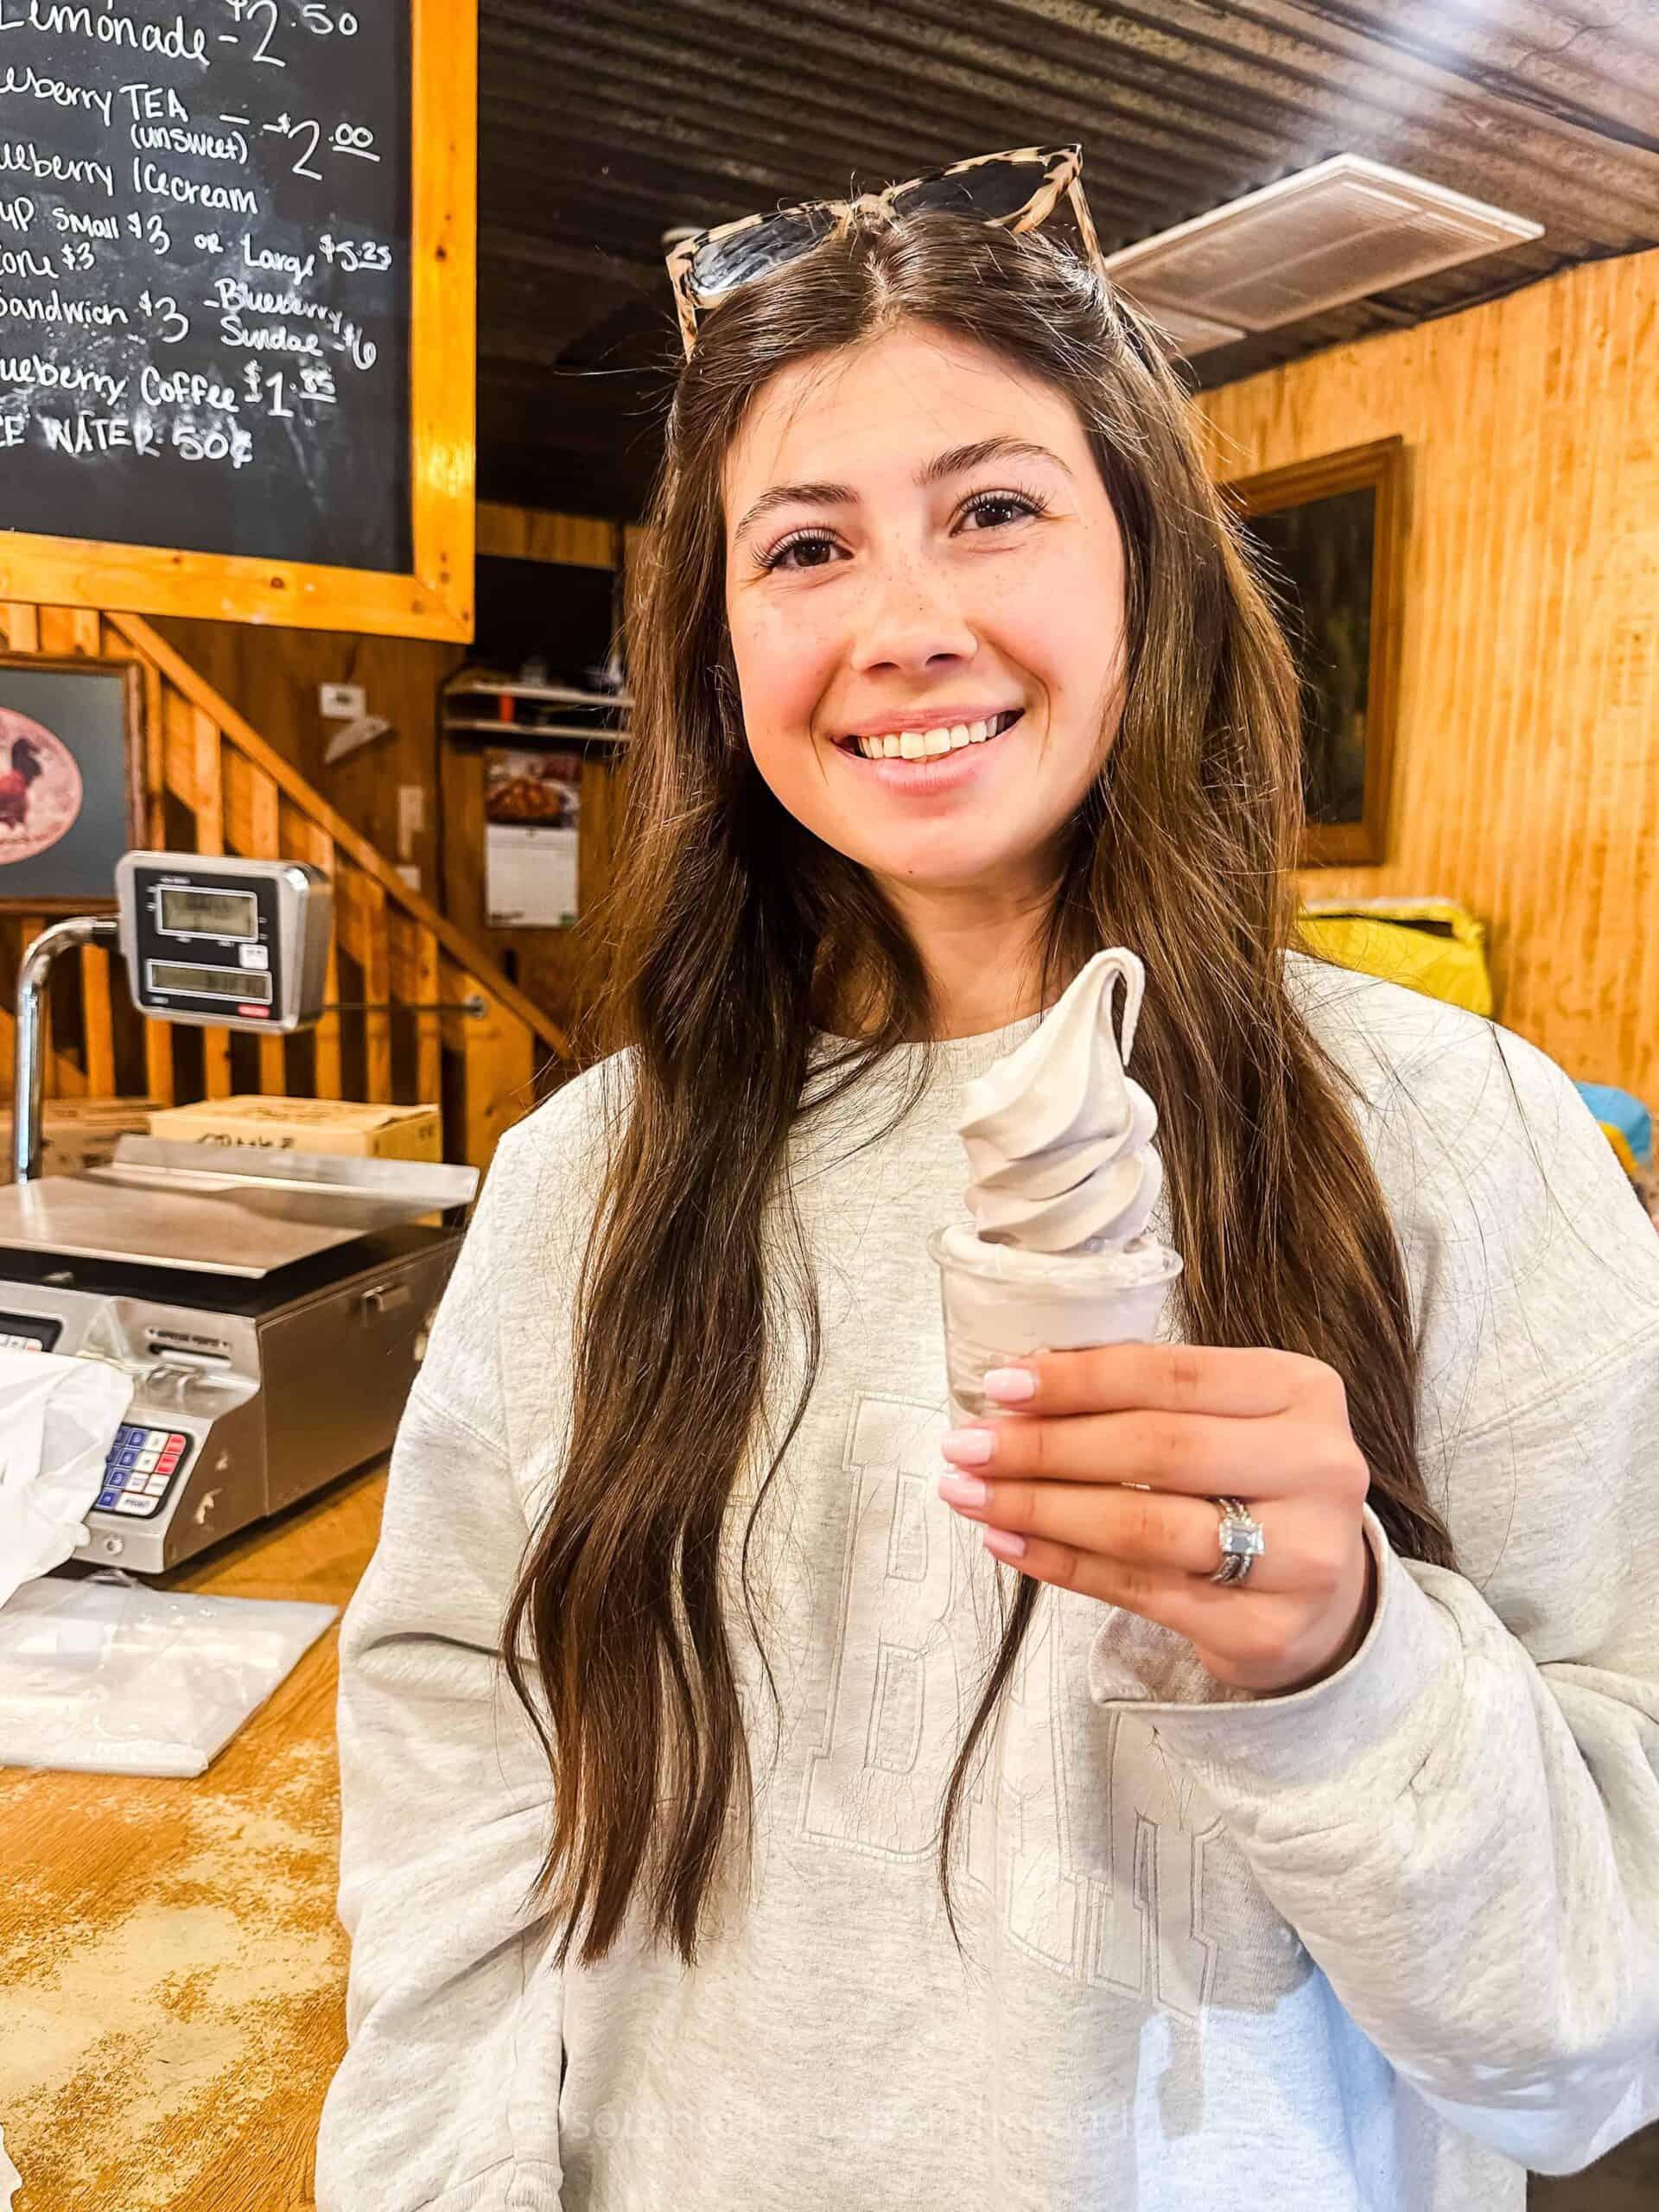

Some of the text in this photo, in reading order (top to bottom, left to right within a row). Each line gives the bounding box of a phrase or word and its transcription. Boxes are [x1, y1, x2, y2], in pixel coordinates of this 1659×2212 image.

[0, 0, 210, 66] Lemonade
[118, 84, 189, 123] TEA
[130, 124, 249, 165] (unsweet)
[128, 212, 171, 256] $3
[60, 242, 95, 270] $3
[139, 290, 189, 344] $3
[140, 365, 240, 413] Coffee
[0, 415, 30, 448] E
